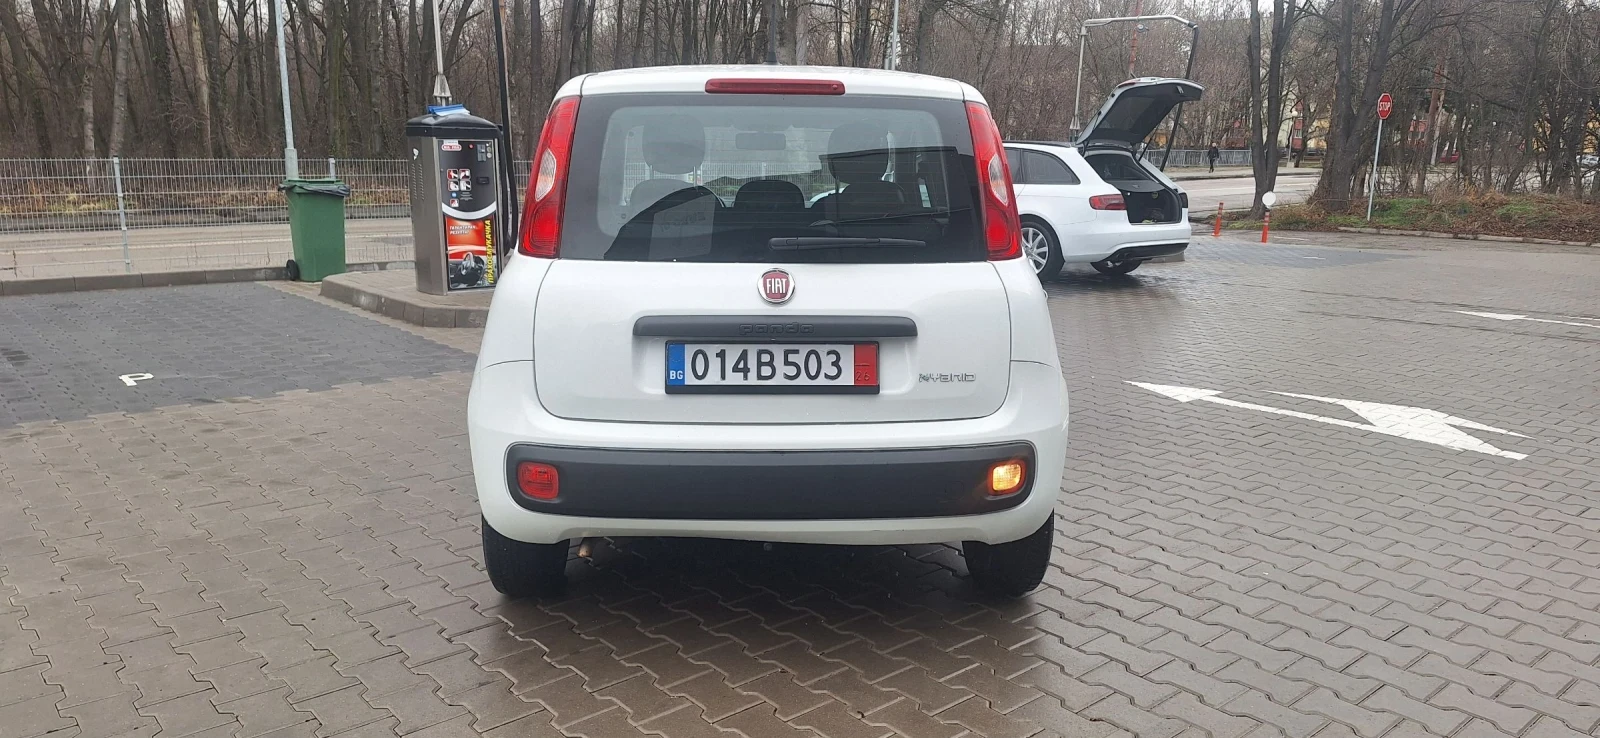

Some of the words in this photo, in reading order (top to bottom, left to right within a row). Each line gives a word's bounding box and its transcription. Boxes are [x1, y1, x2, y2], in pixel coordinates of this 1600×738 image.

[1379, 101, 1391, 111] STOP
[485, 219, 494, 284] ПРАХОСМУКАЧКА
[766, 278, 787, 294] FIAT
[739, 321, 814, 336] panda
[691, 348, 843, 381] 014B503
[669, 370, 684, 380] BG
[855, 371, 870, 381] 26
[918, 373, 976, 383] HYBRID
